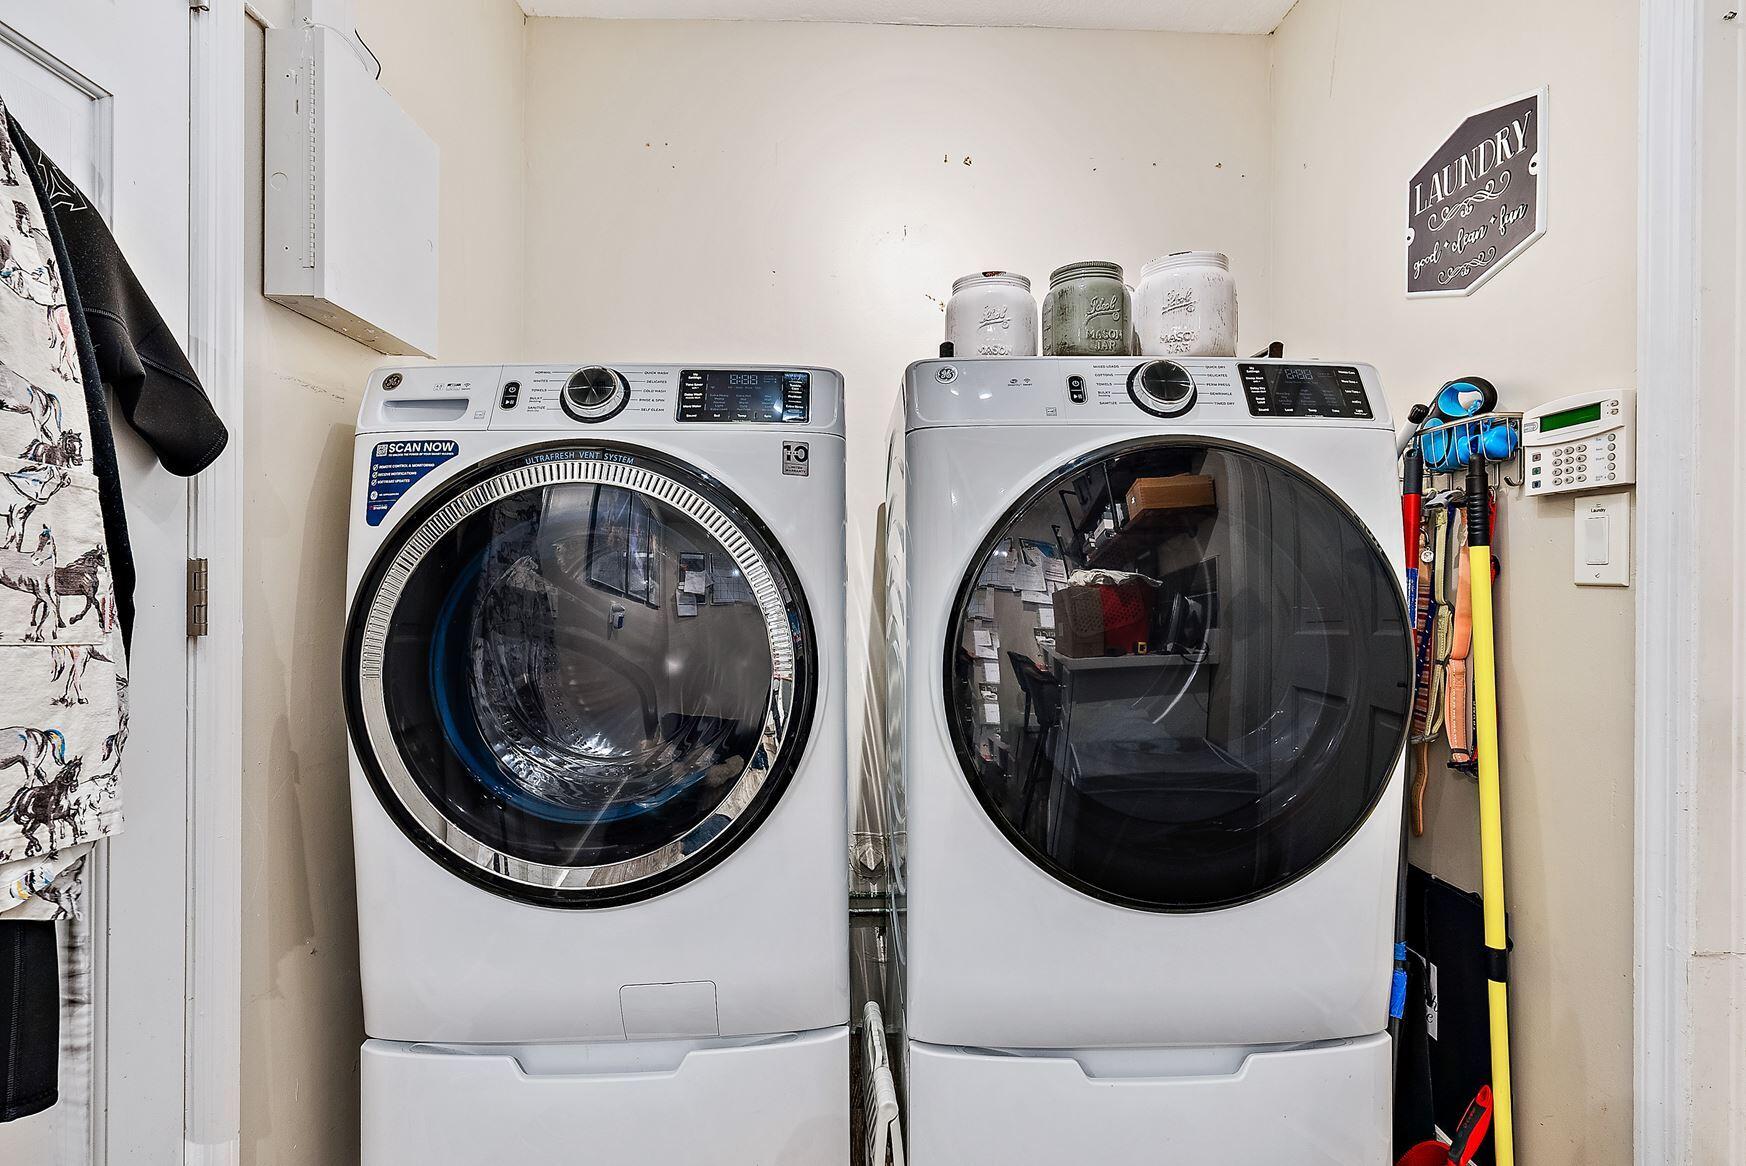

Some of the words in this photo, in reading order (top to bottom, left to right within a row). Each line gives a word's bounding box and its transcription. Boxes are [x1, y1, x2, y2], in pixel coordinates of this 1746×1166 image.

[1414, 110, 1532, 216] LAUNDRY
[1413, 240, 1442, 280] good
[1451, 228, 1488, 254] clean
[1499, 204, 1528, 236] fun
[1085, 329, 1124, 340] MASON
[1159, 331, 1200, 343] MASON
[1095, 340, 1118, 351] JAR
[388, 442, 421, 453] SCAN
[423, 442, 455, 452] NOW
[783, 444, 809, 463] 10
[525, 451, 575, 465] ULTRAFRESH
[578, 451, 600, 461] VENT
[603, 452, 636, 465] SYSTEM
